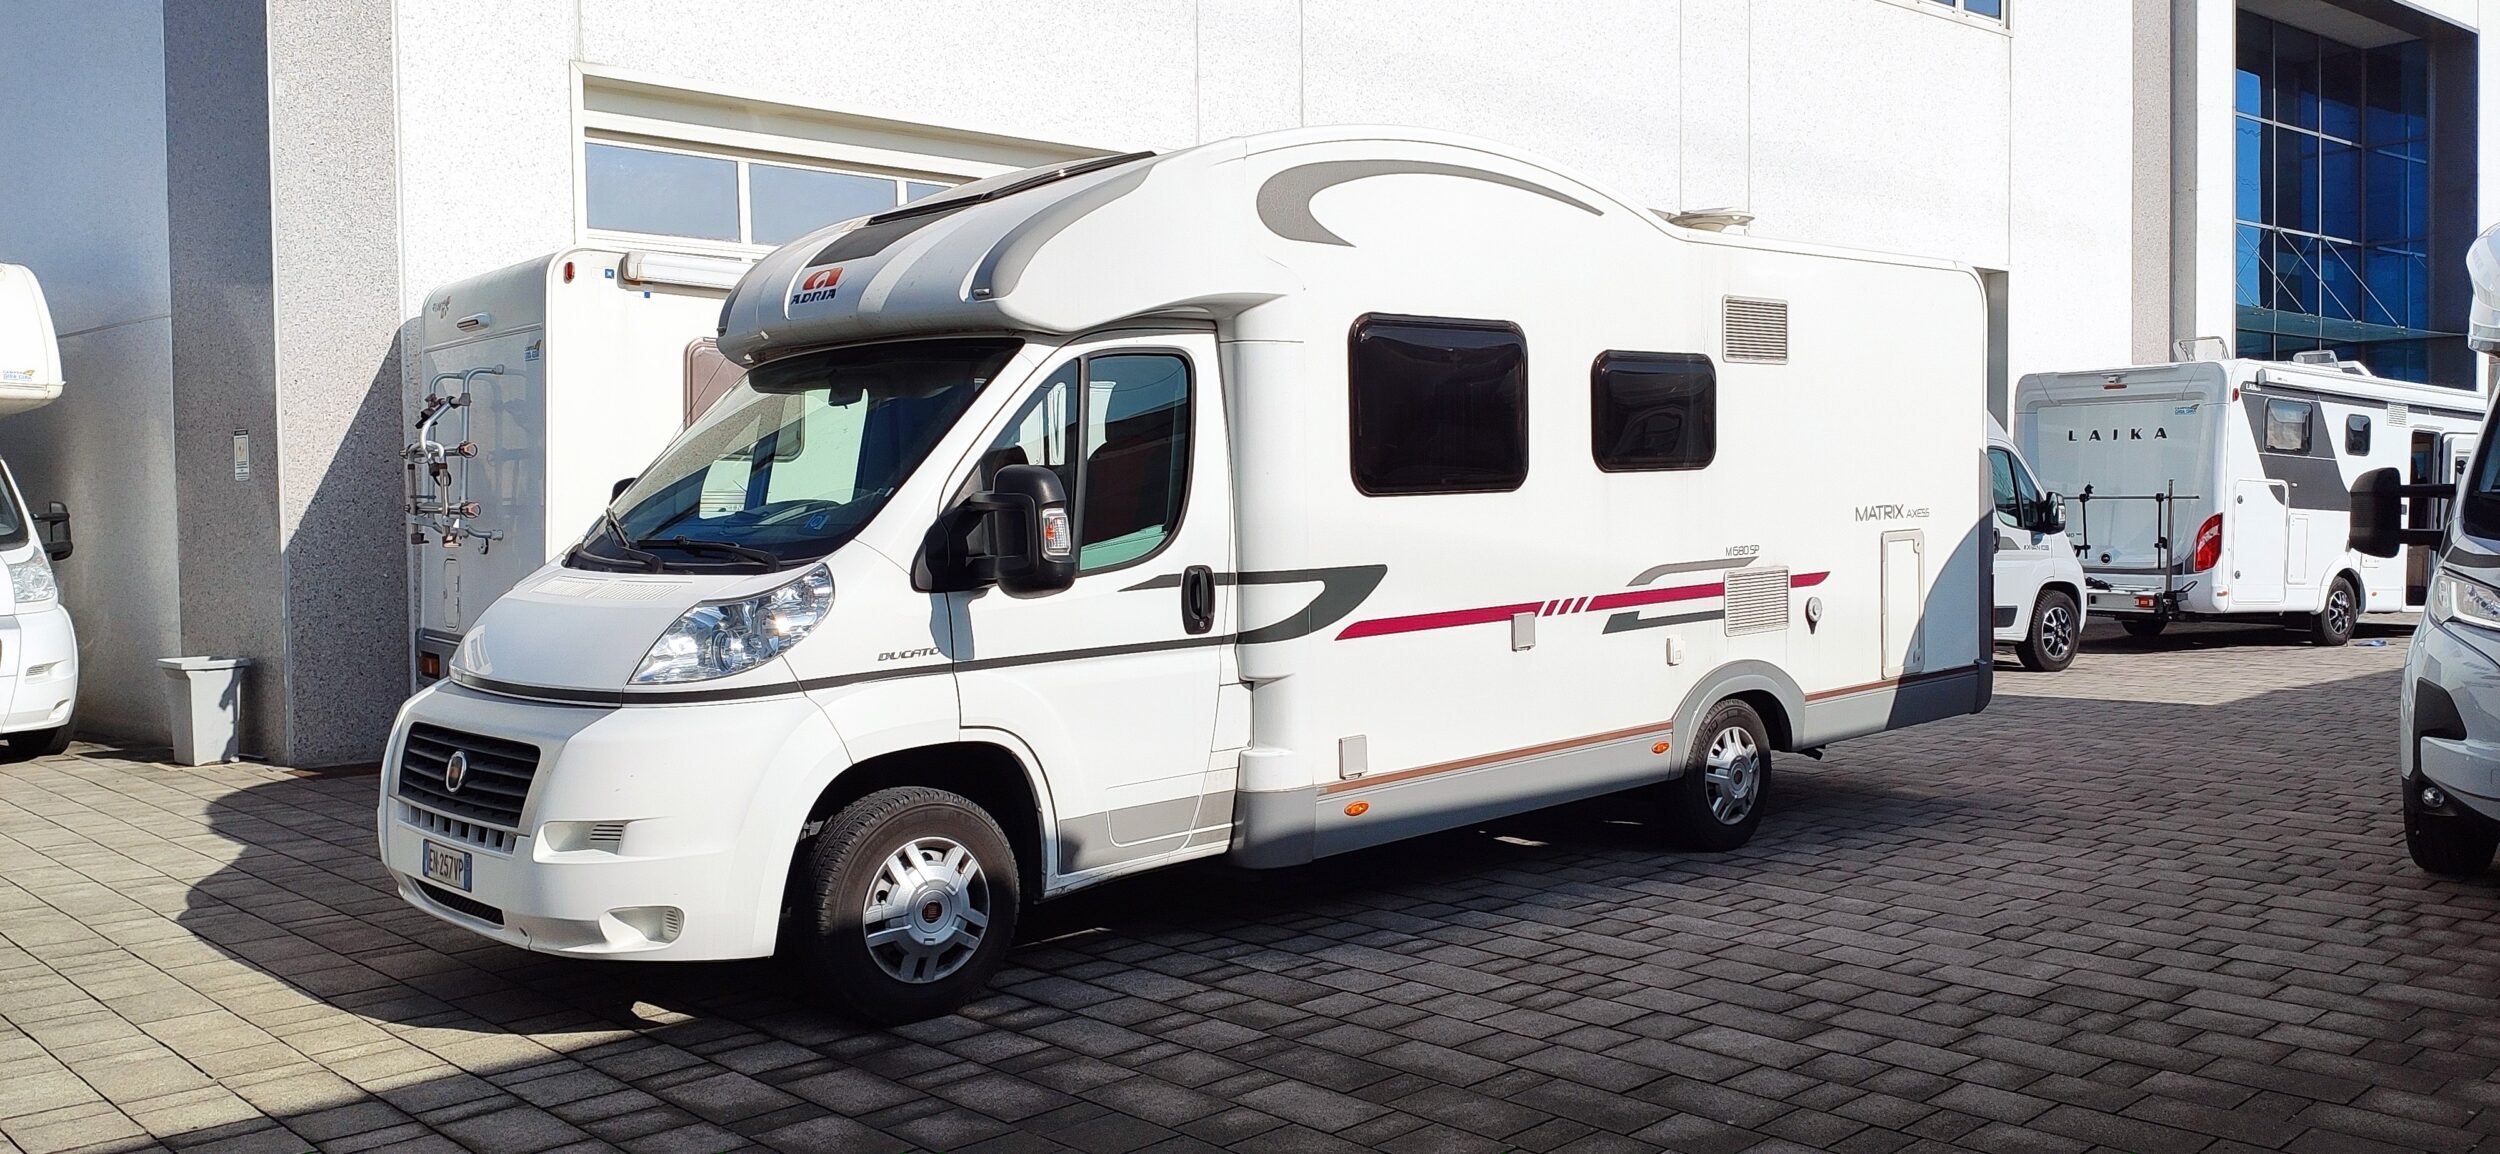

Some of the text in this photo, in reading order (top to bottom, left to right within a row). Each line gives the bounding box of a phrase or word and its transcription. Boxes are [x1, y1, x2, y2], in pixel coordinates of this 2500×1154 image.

[790, 288, 837, 305] ADRIA
[2067, 426, 2168, 442] LAIKA
[1855, 503, 1930, 522] MATRIX AXESS
[877, 646, 940, 662] DUCATO
